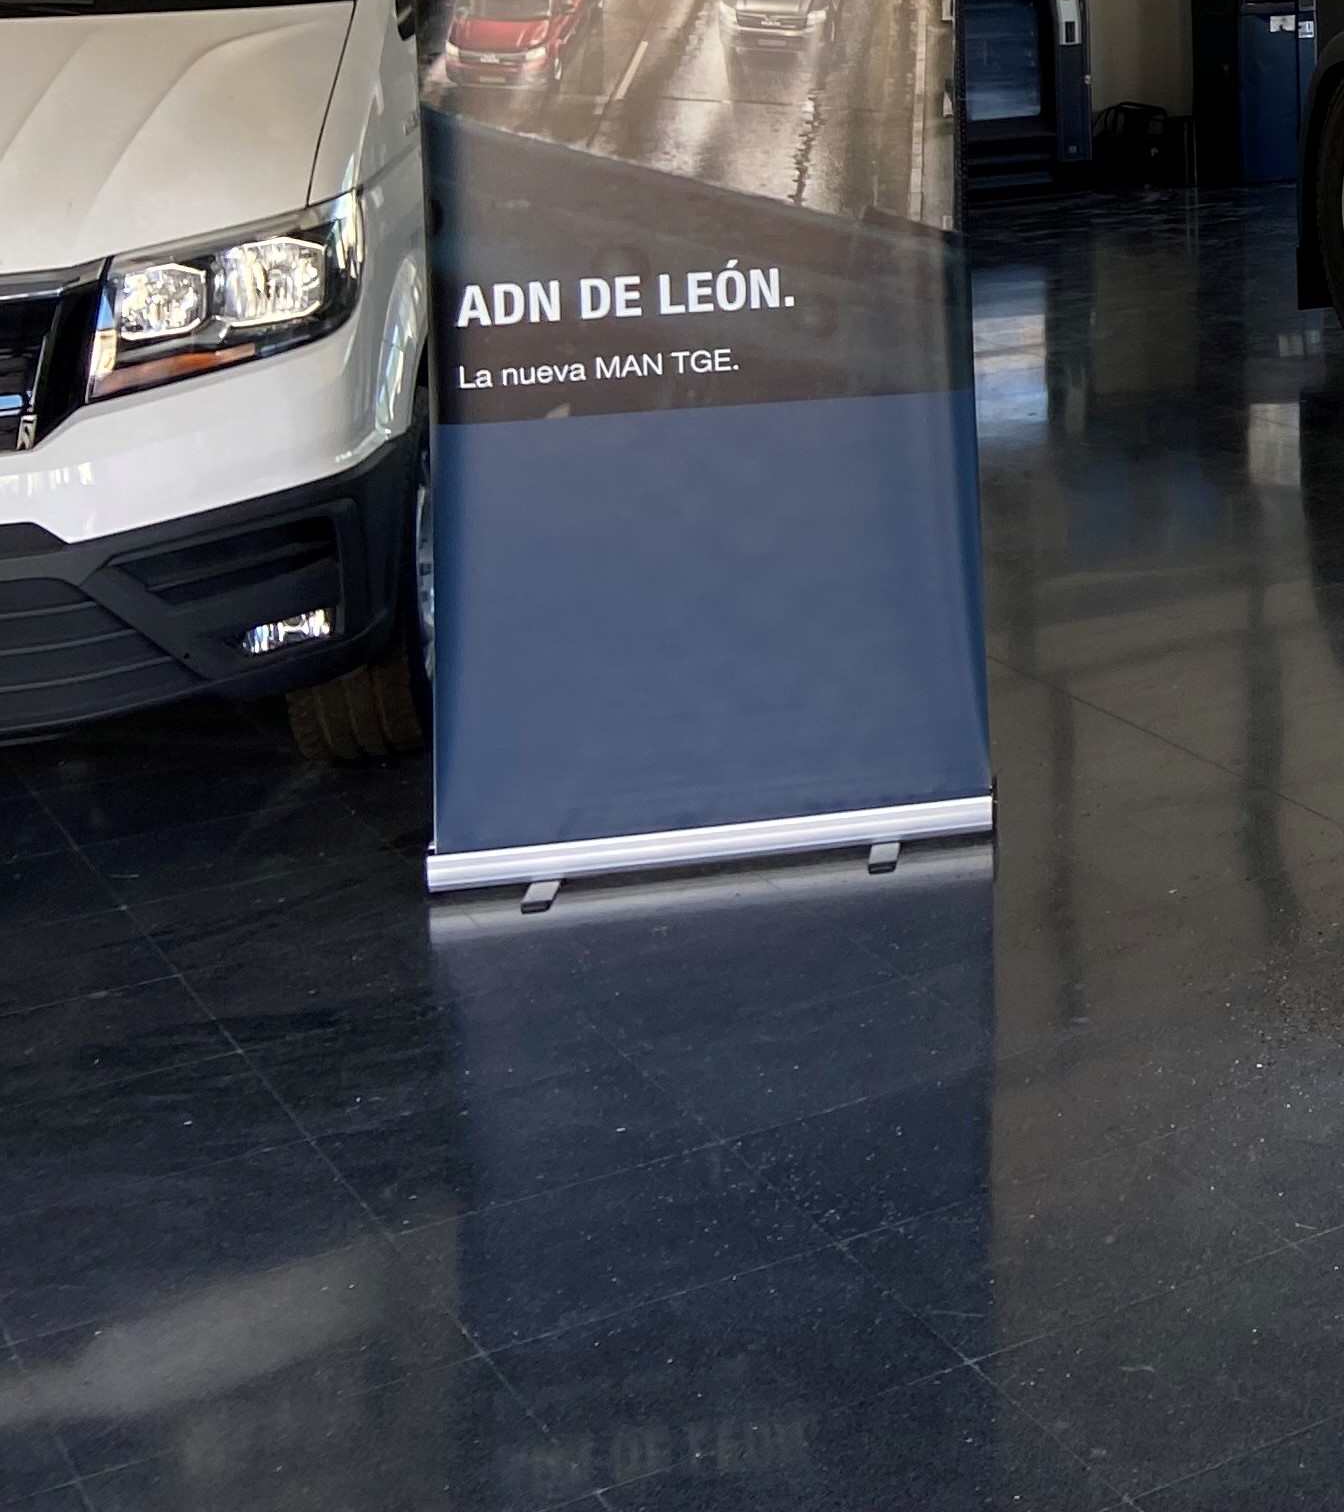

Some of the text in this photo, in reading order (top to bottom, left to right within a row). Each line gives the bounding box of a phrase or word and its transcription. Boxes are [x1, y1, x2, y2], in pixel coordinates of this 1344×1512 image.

[456, 258, 796, 328] ADN DE LEÓN.
[458, 347, 739, 389] La nueva MAN TGE.
